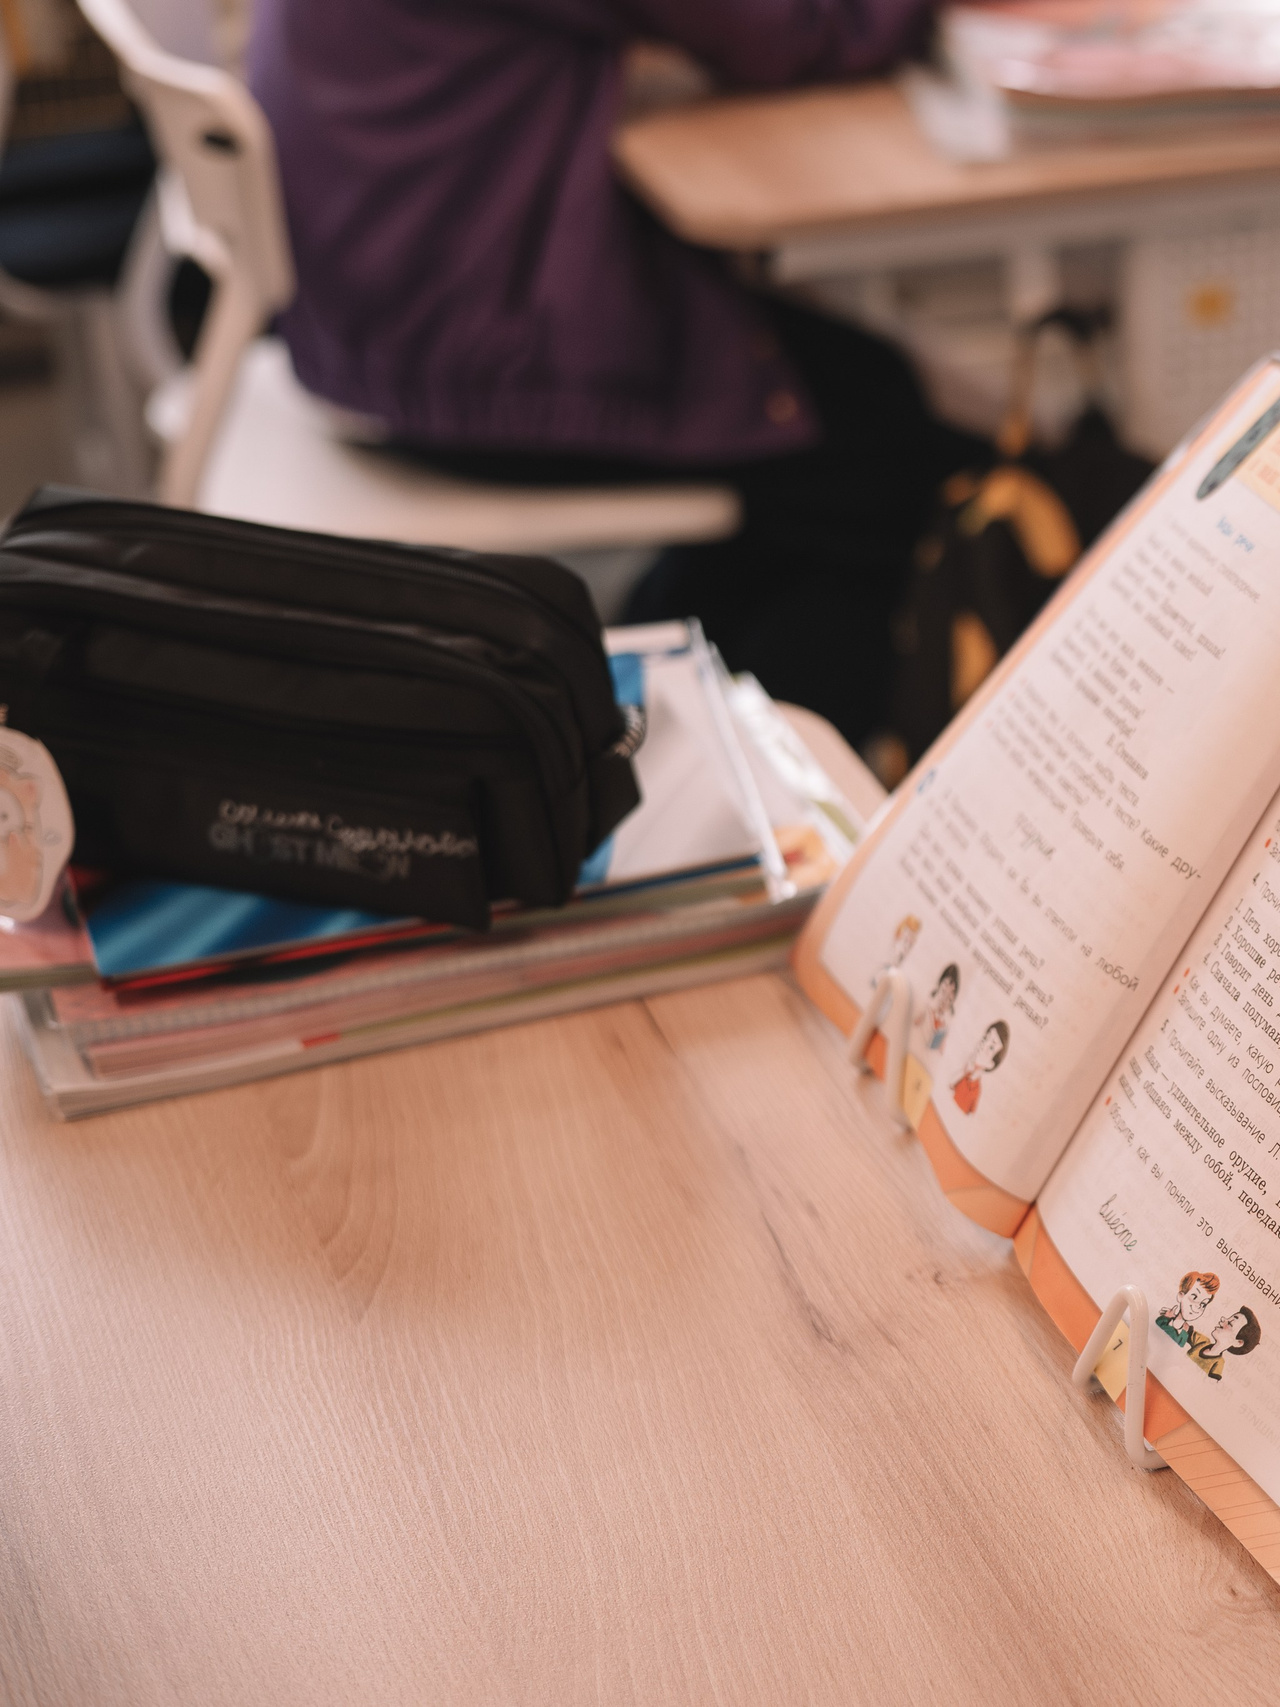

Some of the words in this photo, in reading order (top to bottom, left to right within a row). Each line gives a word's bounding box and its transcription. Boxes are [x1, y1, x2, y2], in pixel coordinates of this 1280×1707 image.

[1140, 827, 1169, 858] Какие
[1170, 856, 1202, 880] дру-
[1231, 924, 1267, 970] Хорошие
[1242, 906, 1262, 935] Петь
[1080, 943, 1092, 958] на
[1095, 956, 1140, 992] любой
[1209, 960, 1242, 1003] Сначала
[1220, 942, 1253, 983] Говорит
[1250, 982, 1274, 1008] день
[1206, 1029, 1227, 1056] одну
[1226, 1052, 1241, 1069] из
[1209, 1005, 1243, 1046] думаете,
[1245, 1043, 1275, 1075] какую
[1169, 1028, 1205, 1080] Прочитайте
[1205, 1077, 1266, 1145] высказывание
[1142, 1080, 1173, 1120] общаясь
[1172, 1118, 1203, 1155] между
[1203, 1153, 1234, 1192] собой,
[1166, 1081, 1226, 1149] удивительное
[1228, 1150, 1267, 1196] орудие,
[1136, 1145, 1151, 1165] как
[1150, 1162, 1164, 1181] вы
[1164, 1179, 1196, 1218] поняли
[1196, 1216, 1214, 1238] это
